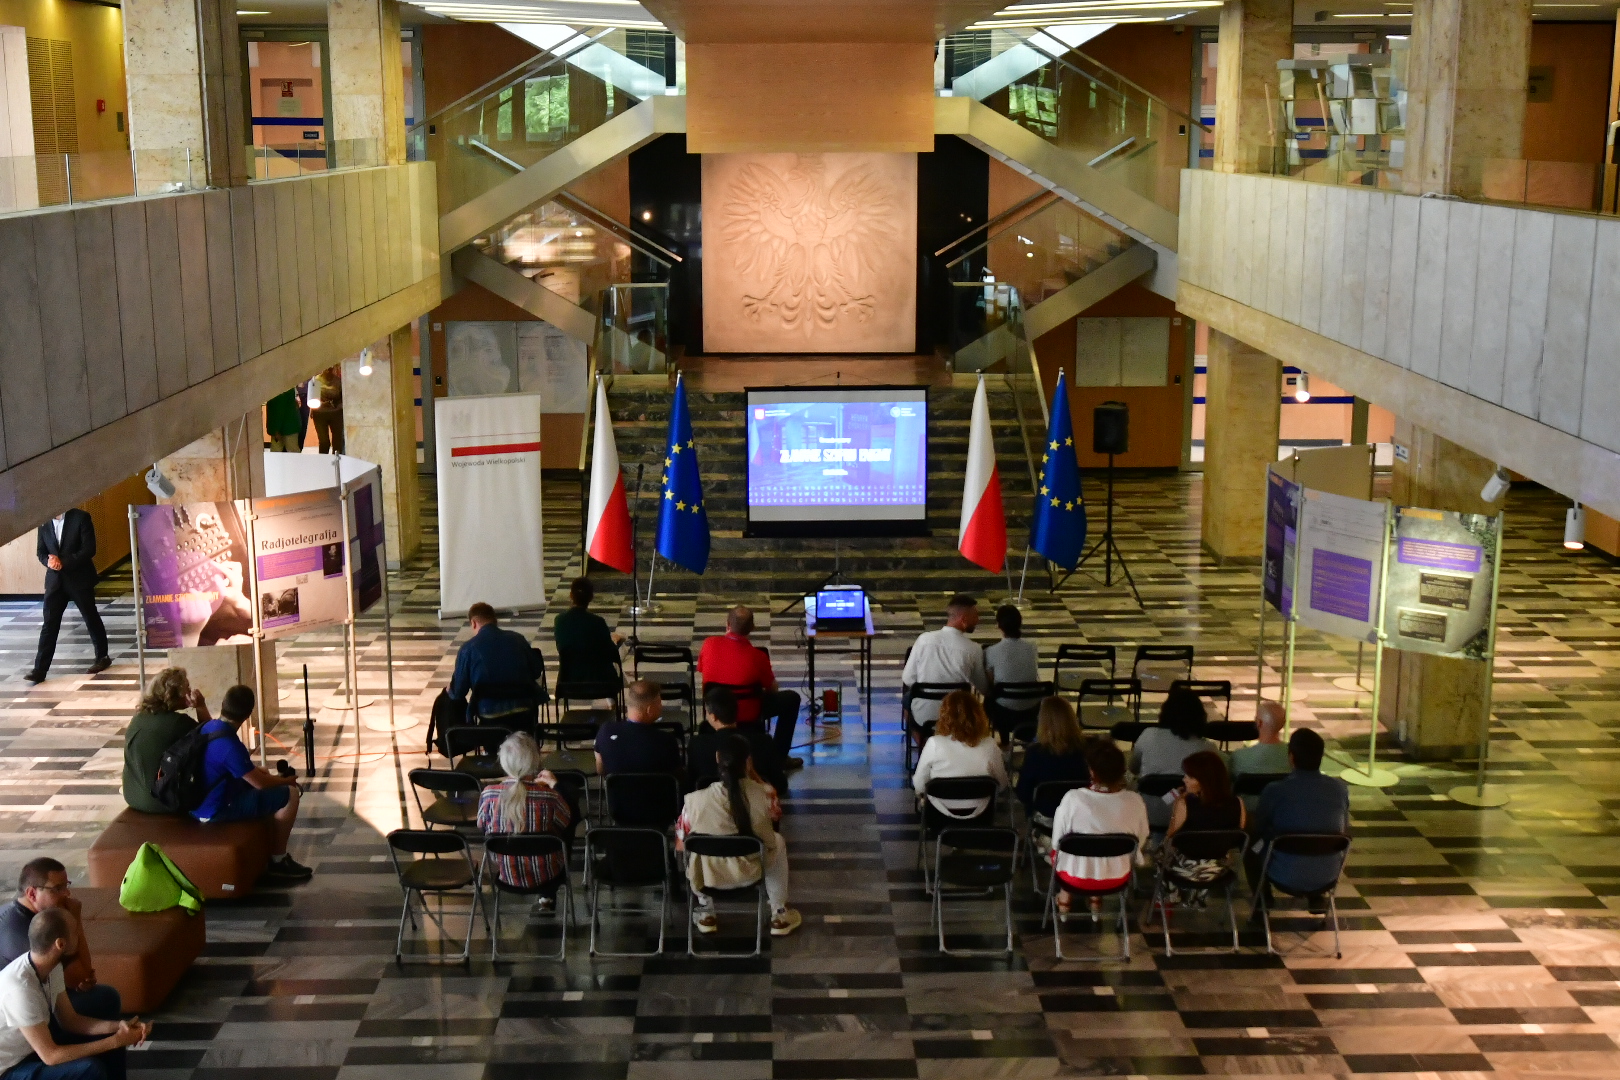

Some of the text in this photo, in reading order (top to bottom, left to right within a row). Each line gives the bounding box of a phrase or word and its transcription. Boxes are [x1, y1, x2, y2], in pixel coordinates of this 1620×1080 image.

[451, 457, 526, 468] Wojewoda Wielkopolski
[261, 529, 337, 551] Radjotelegrafja
